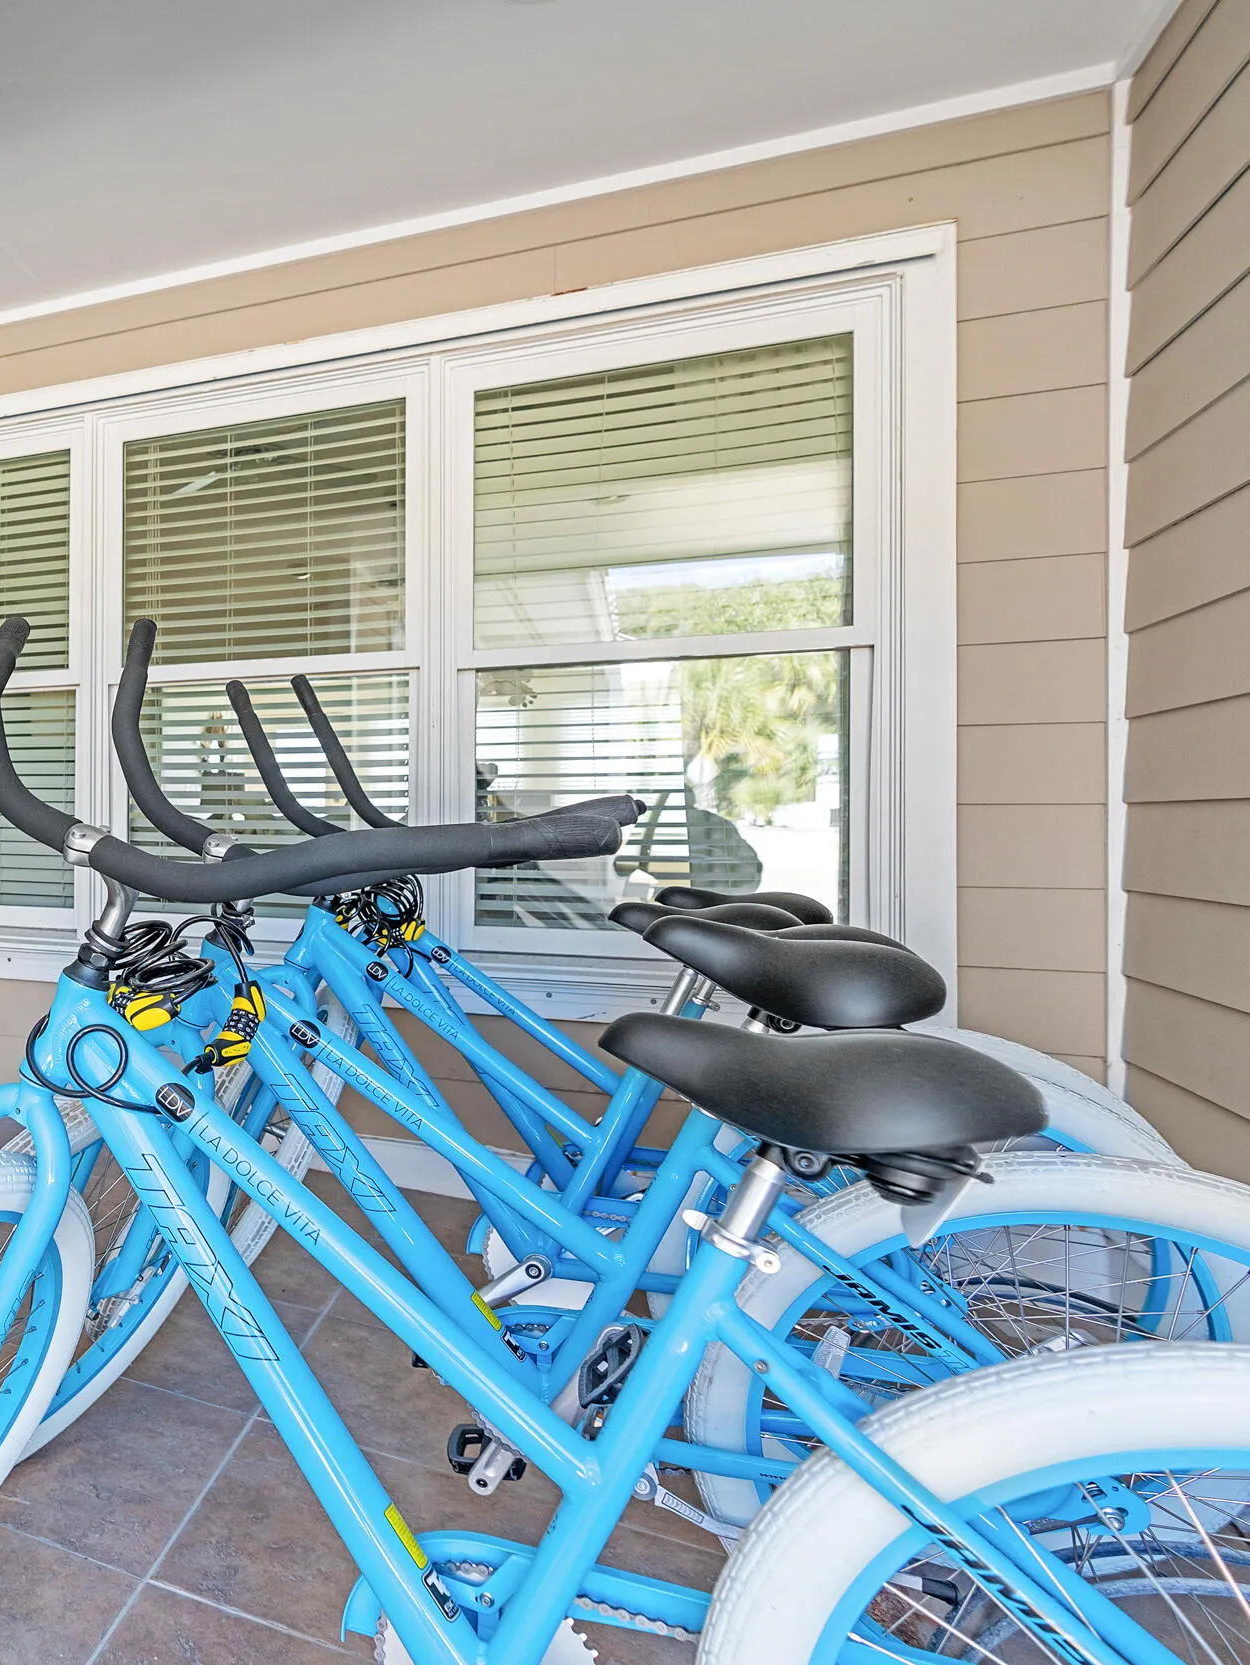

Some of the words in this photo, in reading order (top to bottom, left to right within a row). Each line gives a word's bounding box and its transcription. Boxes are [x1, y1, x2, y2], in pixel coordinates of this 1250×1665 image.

[367, 964, 388, 980] LDV
[391, 980, 405, 998] LA
[404, 993, 438, 1021] DOLCE
[438, 1015, 460, 1041] VITA
[291, 1023, 320, 1046] LDV
[157, 1086, 192, 1118] LDV
[325, 1050, 345, 1072] LA
[346, 1066, 394, 1105] DOLCE
[393, 1100, 424, 1131] VITA
[269, 1072, 397, 1213] TAXI
[198, 1125, 222, 1153] LA
[222, 1147, 283, 1207] DOLCE
[283, 1202, 322, 1246] VITA
[125, 1153, 281, 1362] TAXI
[822, 1264, 943, 1350] JAMIS
